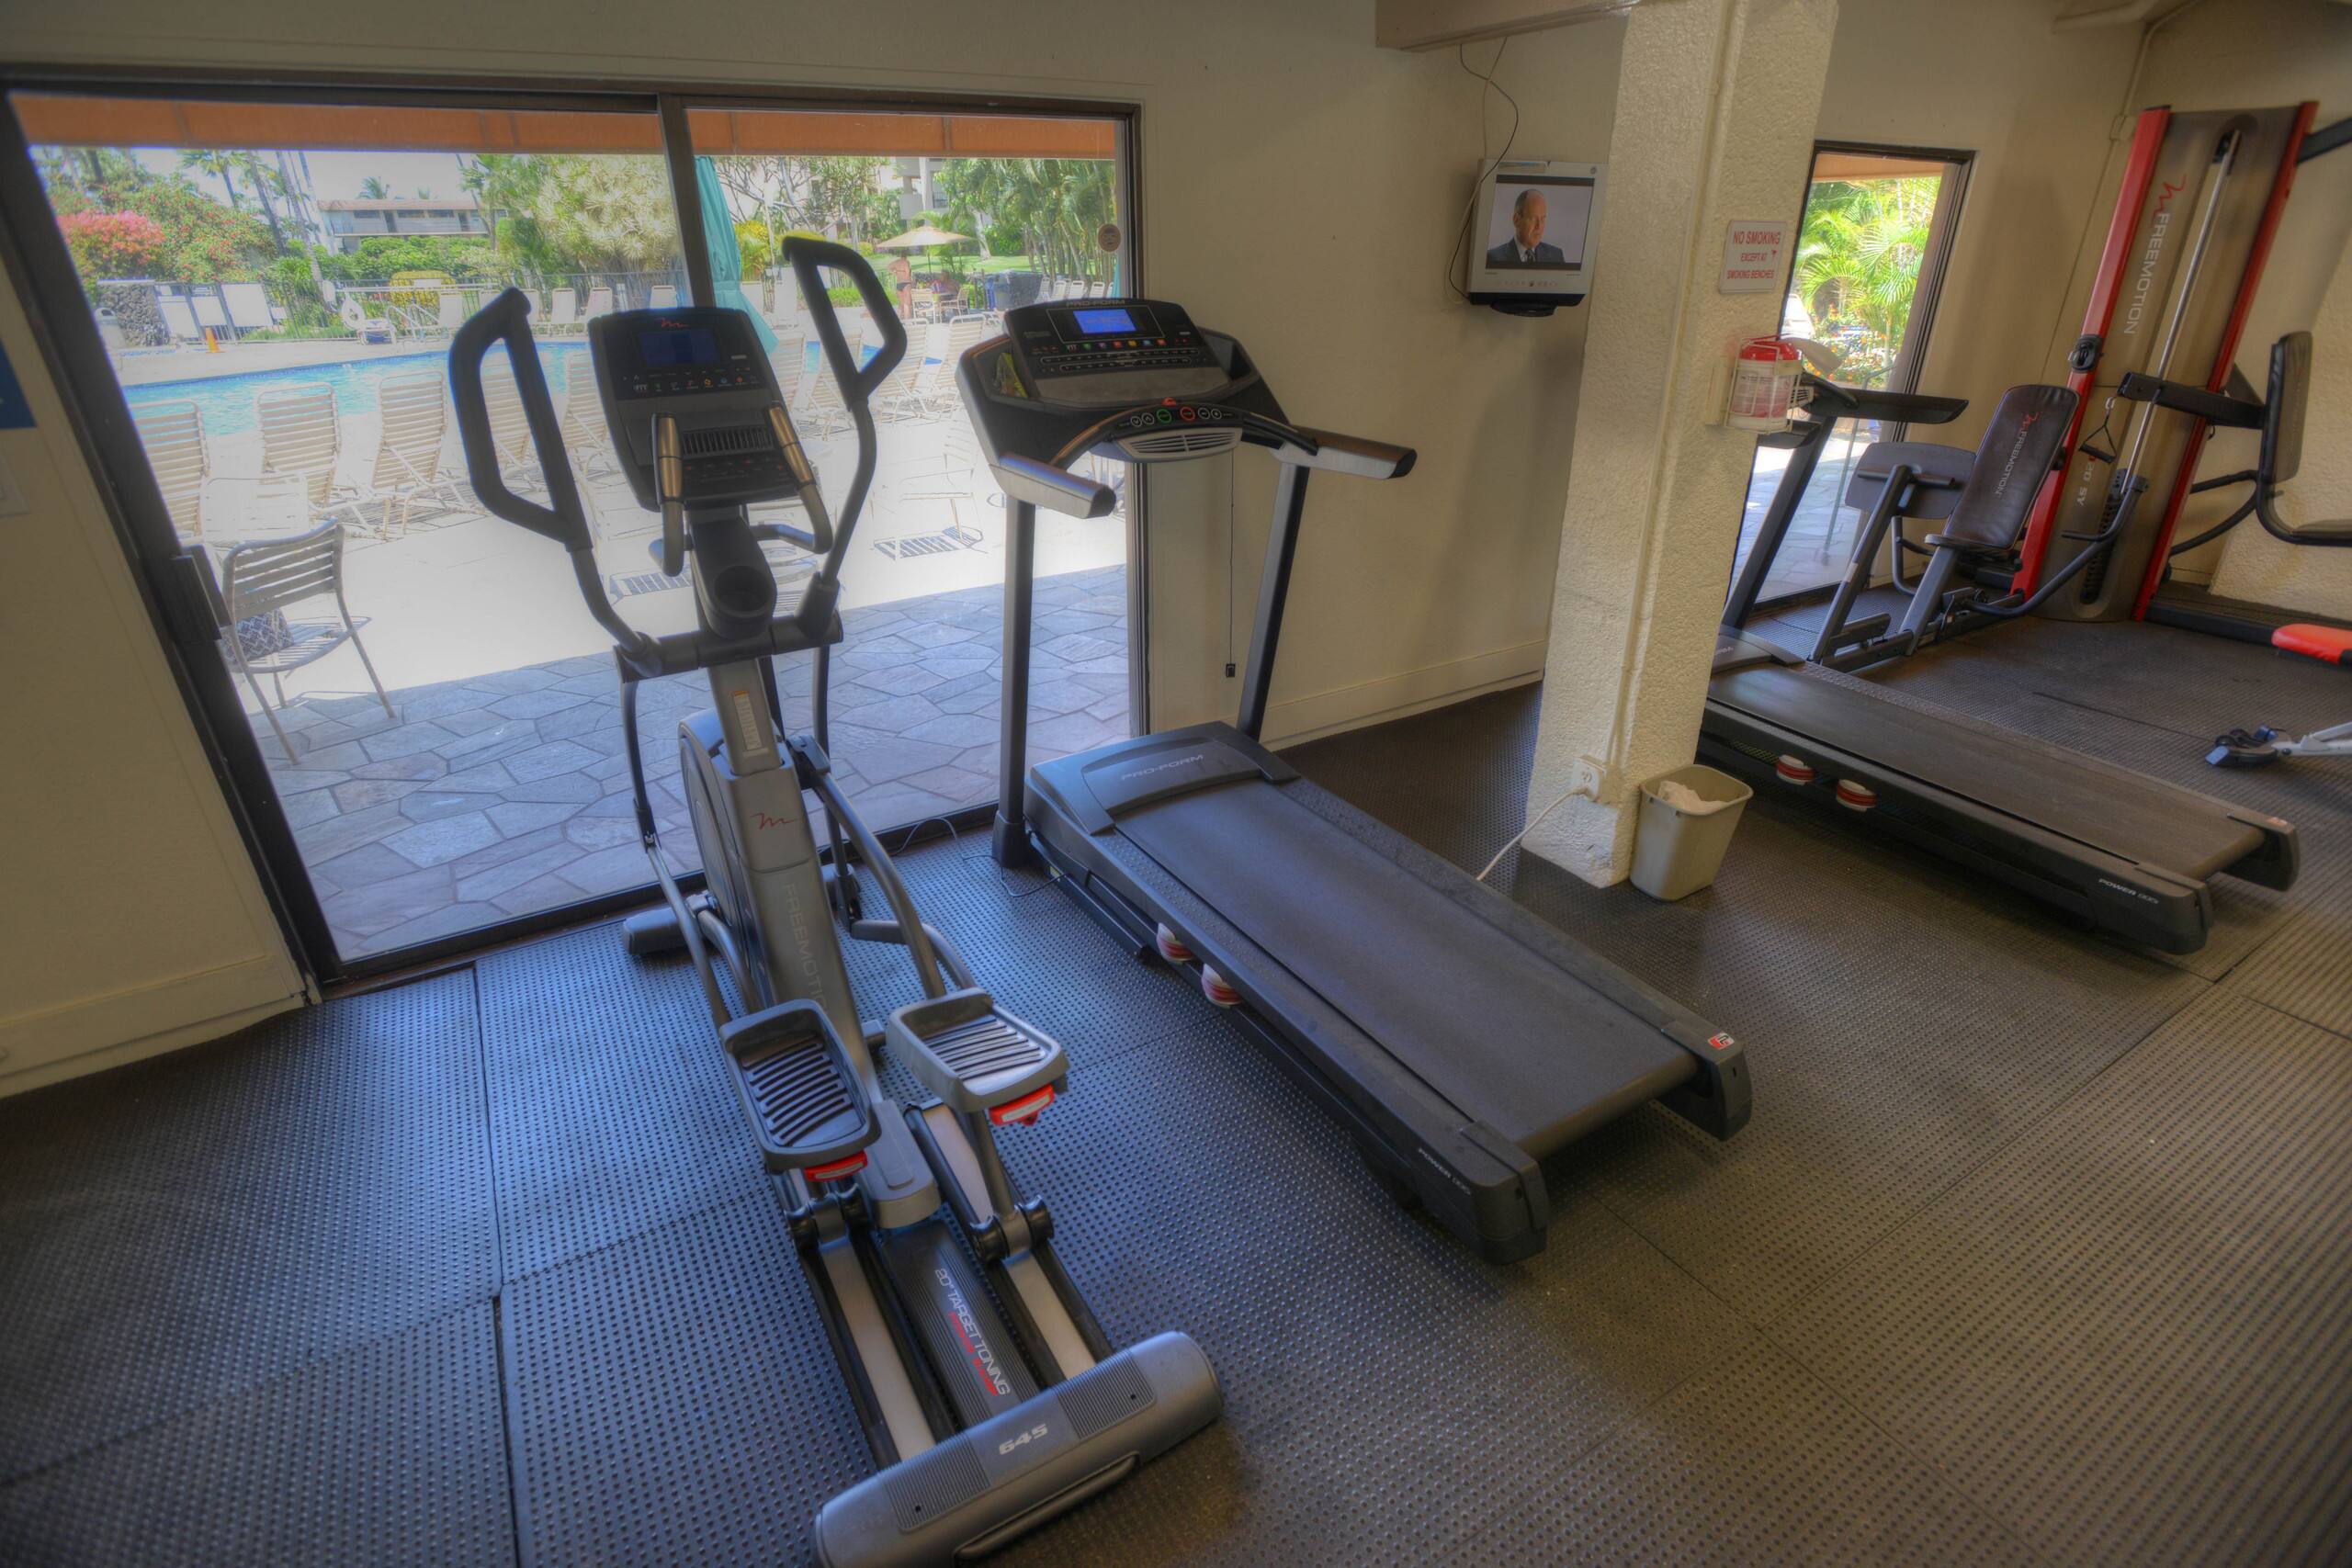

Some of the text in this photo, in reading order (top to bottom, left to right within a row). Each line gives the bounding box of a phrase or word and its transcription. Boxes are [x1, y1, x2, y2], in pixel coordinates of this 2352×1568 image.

[1733, 230, 1781, 245] NO SMOKING
[2123, 213, 2171, 334] FREEMOTION
[1995, 431, 2028, 496] FREEMOTION
[947, 1290, 982, 1338] TARGET
[974, 1338, 1011, 1395] TONING
[999, 1423, 1048, 1456] 645
